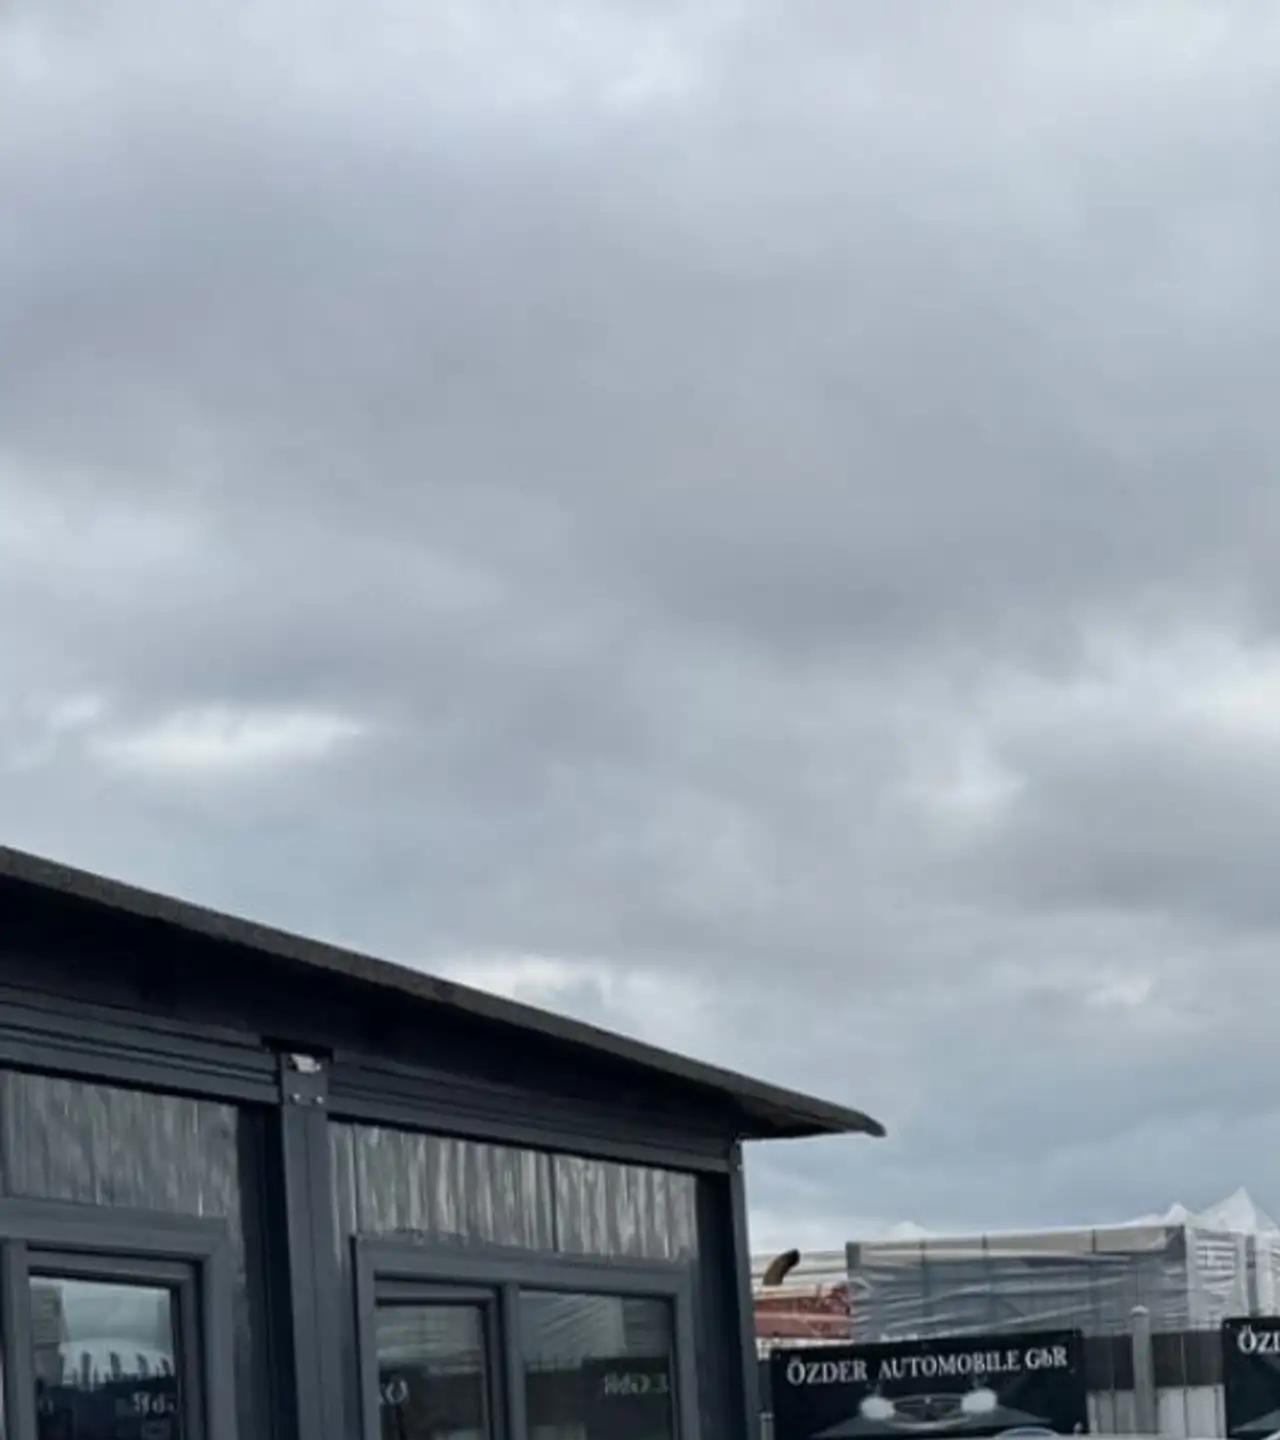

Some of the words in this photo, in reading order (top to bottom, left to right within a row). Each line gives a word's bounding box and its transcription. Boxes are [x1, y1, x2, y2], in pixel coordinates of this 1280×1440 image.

[786, 1357, 868, 1385] ÖZDER
[878, 1350, 1021, 1380] AUTOMOBILE
[1024, 1346, 1068, 1370] GbR
